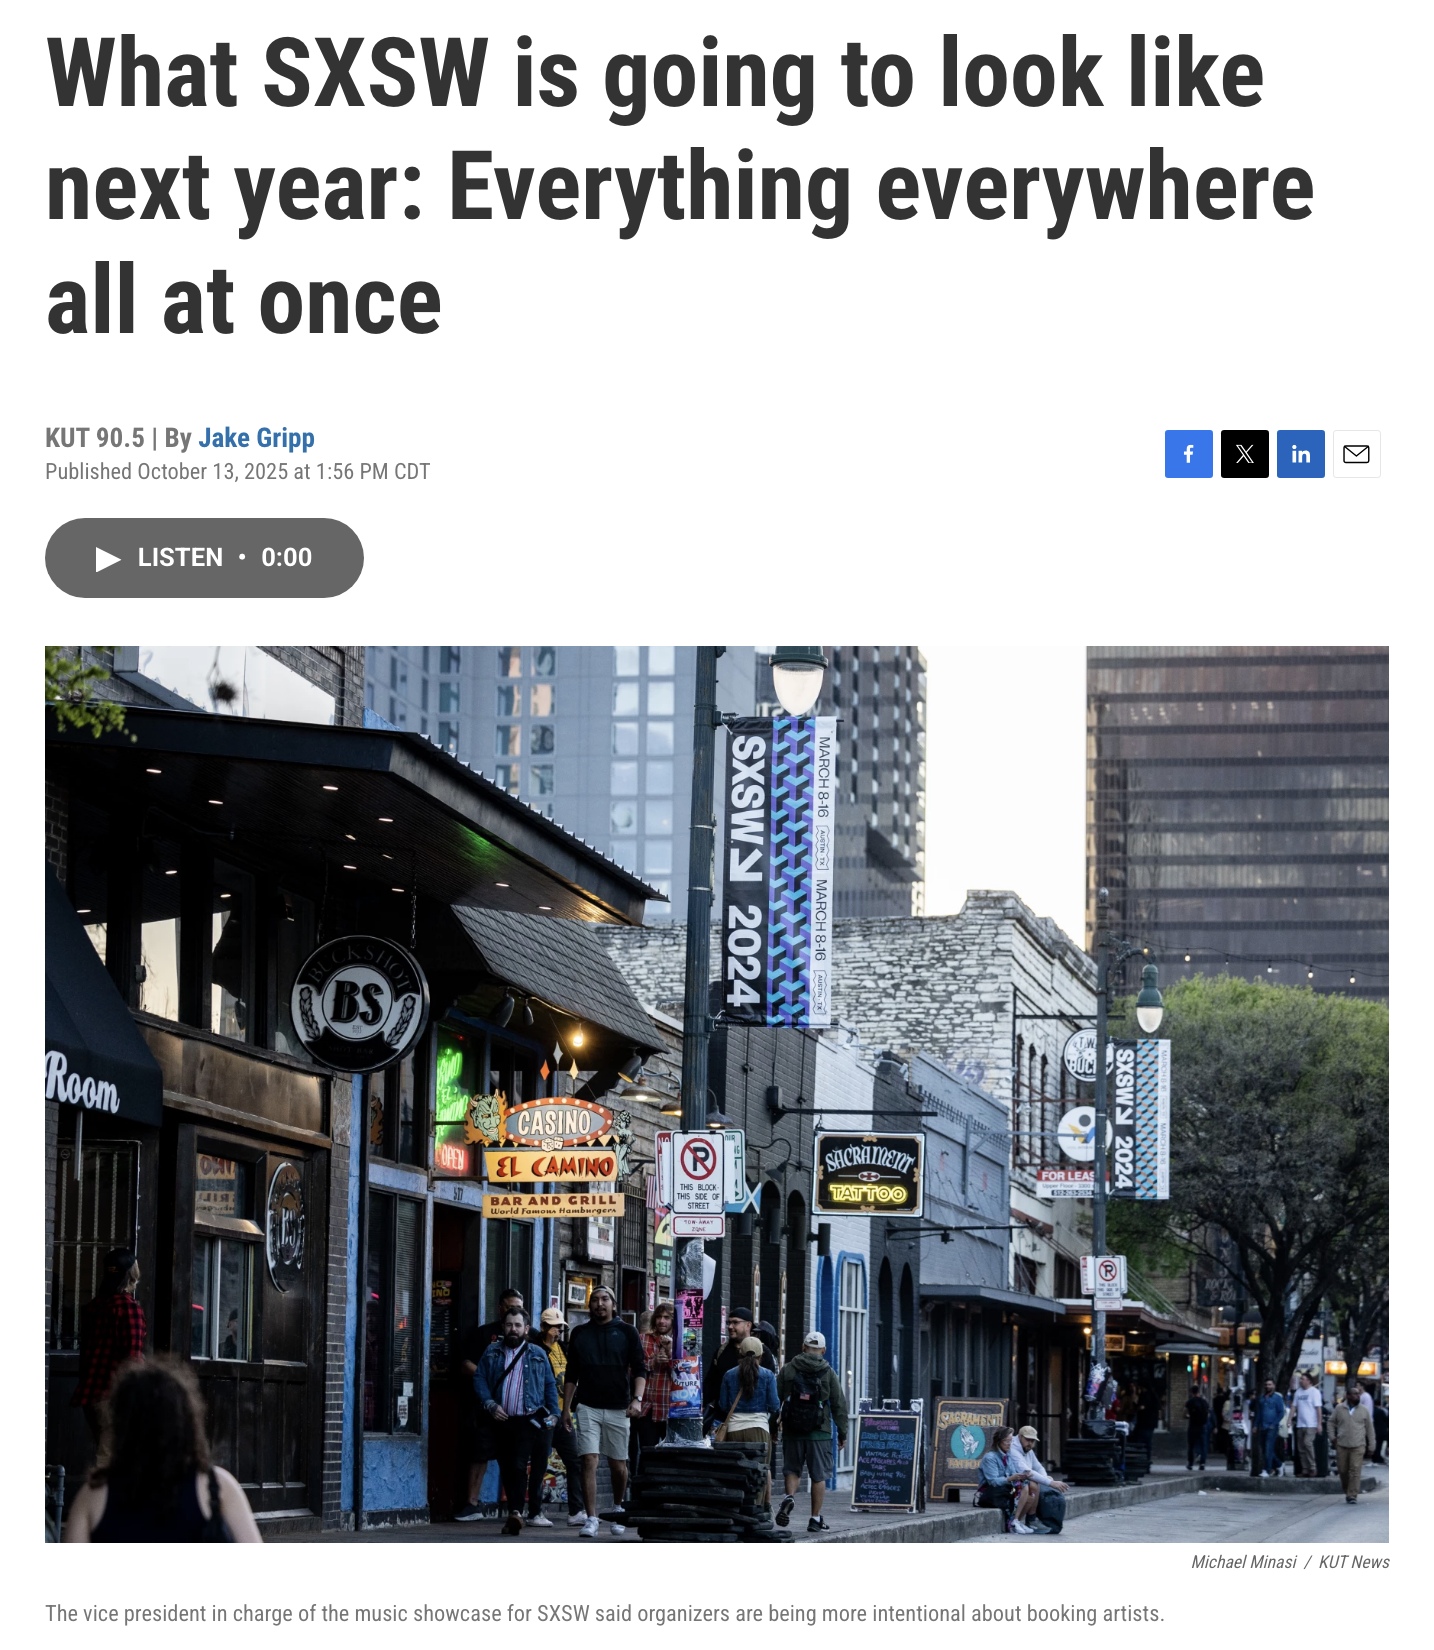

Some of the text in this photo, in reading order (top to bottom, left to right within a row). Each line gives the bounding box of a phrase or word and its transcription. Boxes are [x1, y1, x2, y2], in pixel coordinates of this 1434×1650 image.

[818, 736, 830, 789] MARCH
[817, 791, 829, 818] 8-16
[726, 735, 766, 1007] SXSW 2024
[815, 879, 828, 932] MARCH
[814, 934, 826, 961] 8-16
[308, 943, 413, 990] BUCKSHOT
[331, 980, 384, 1026] BS
[517, 1109, 592, 1136] CASINO
[1114, 1048, 1135, 1189] SXSW 2024
[441, 1146, 465, 1170] OPEN
[497, 1156, 614, 1178] EL CAMINO
[825, 1144, 916, 1174] SACRAMENT
[680, 1183, 693, 1191] THIS
[1042, 1171, 1095, 1181] FOR LEAS
[490, 1195, 617, 1206] BAR AND GRILL
[688, 1202, 710, 1210] STREET
[829, 1184, 907, 1203] TATTOO
[490, 1207, 617, 1217] World Famous Hamburgers
[671, 1389, 699, 1401] NOW
[938, 1411, 1002, 1429] SACRAMENT
